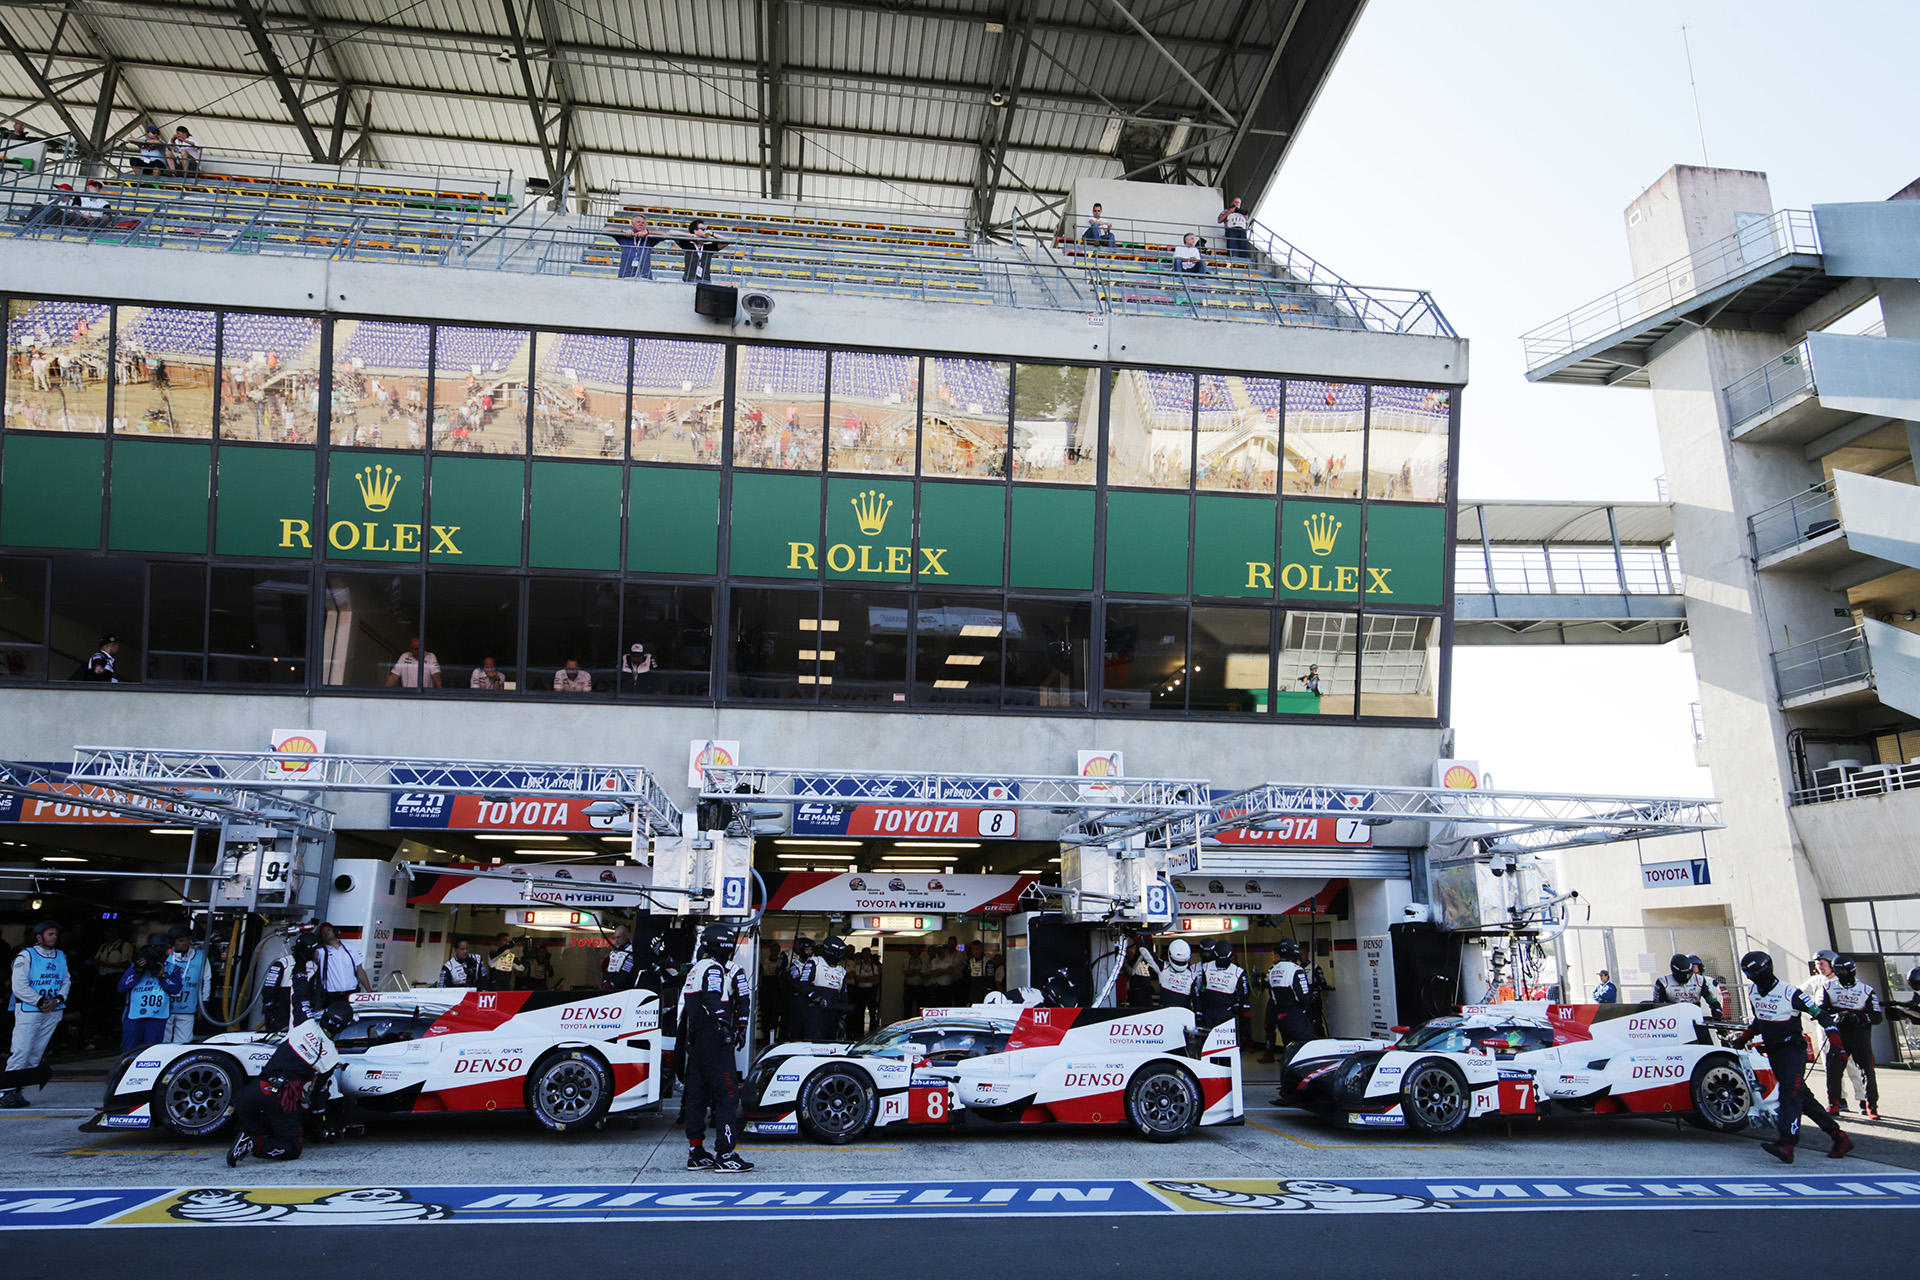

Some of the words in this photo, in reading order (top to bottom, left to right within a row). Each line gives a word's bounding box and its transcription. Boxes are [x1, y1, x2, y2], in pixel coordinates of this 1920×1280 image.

[278, 518, 463, 555] ROLEX
[786, 542, 950, 577] ROLEX
[1245, 562, 1394, 595] ROLEX
[395, 806, 408, 814] LE
[411, 806, 442, 815] MANS
[477, 801, 568, 826] TOYOTA
[797, 813, 808, 821] LE
[811, 814, 841, 822] MANS
[873, 809, 959, 833] TOYOTA
[990, 814, 1003, 833] 8
[1348, 821, 1359, 839] 7
[1168, 853, 1189, 868] TOYOTA
[1645, 866, 1689, 882] TOYOTA
[1696, 860, 1705, 884] 7
[519, 891, 562, 901] TYOTA
[564, 893, 615, 902] HYBRID
[727, 879, 741, 906] 9
[856, 899, 897, 908] TOYOTA
[899, 900, 946, 909] HYBRID
[1149, 887, 1166, 913] 8
[1178, 901, 1217, 910] TOYOTA
[1218, 902, 1262, 910] HYBRID
[527, 912, 534, 922] 9
[572, 913, 579, 923] 9
[873, 918, 879, 928] 8
[915, 918, 922, 928] 8
[1184, 920, 1191, 929] 7
[1224, 920, 1230, 929] 7
[571, 938, 615, 947] TOYOTA
[1363, 940, 1383, 949] DENSO
[140, 994, 163, 1008] 308
[355, 994, 383, 1002] ZENT
[478, 994, 496, 1009] HY
[925, 1008, 949, 1017] ZENT
[1466, 1006, 1487, 1014] ZENT
[1755, 1002, 1778, 1010] DENSO
[560, 1006, 623, 1021] DENSO
[1034, 1011, 1049, 1024] HY
[1558, 1007, 1573, 1020] HY
[1109, 1024, 1164, 1036] DENSO
[1628, 1018, 1677, 1031] DENSO
[137, 1061, 161, 1069] AISIN
[454, 1057, 523, 1074] DENSO
[1632, 1065, 1685, 1079] DENSO
[1064, 1073, 1125, 1087] DENSO
[1477, 1095, 1491, 1107] P1
[1514, 1084, 1530, 1110] 7
[886, 1101, 899, 1114] P1
[926, 1091, 944, 1119] 8
[108, 1115, 150, 1125] MICHELIN
[461, 1187, 1114, 1209] MICHELIN
